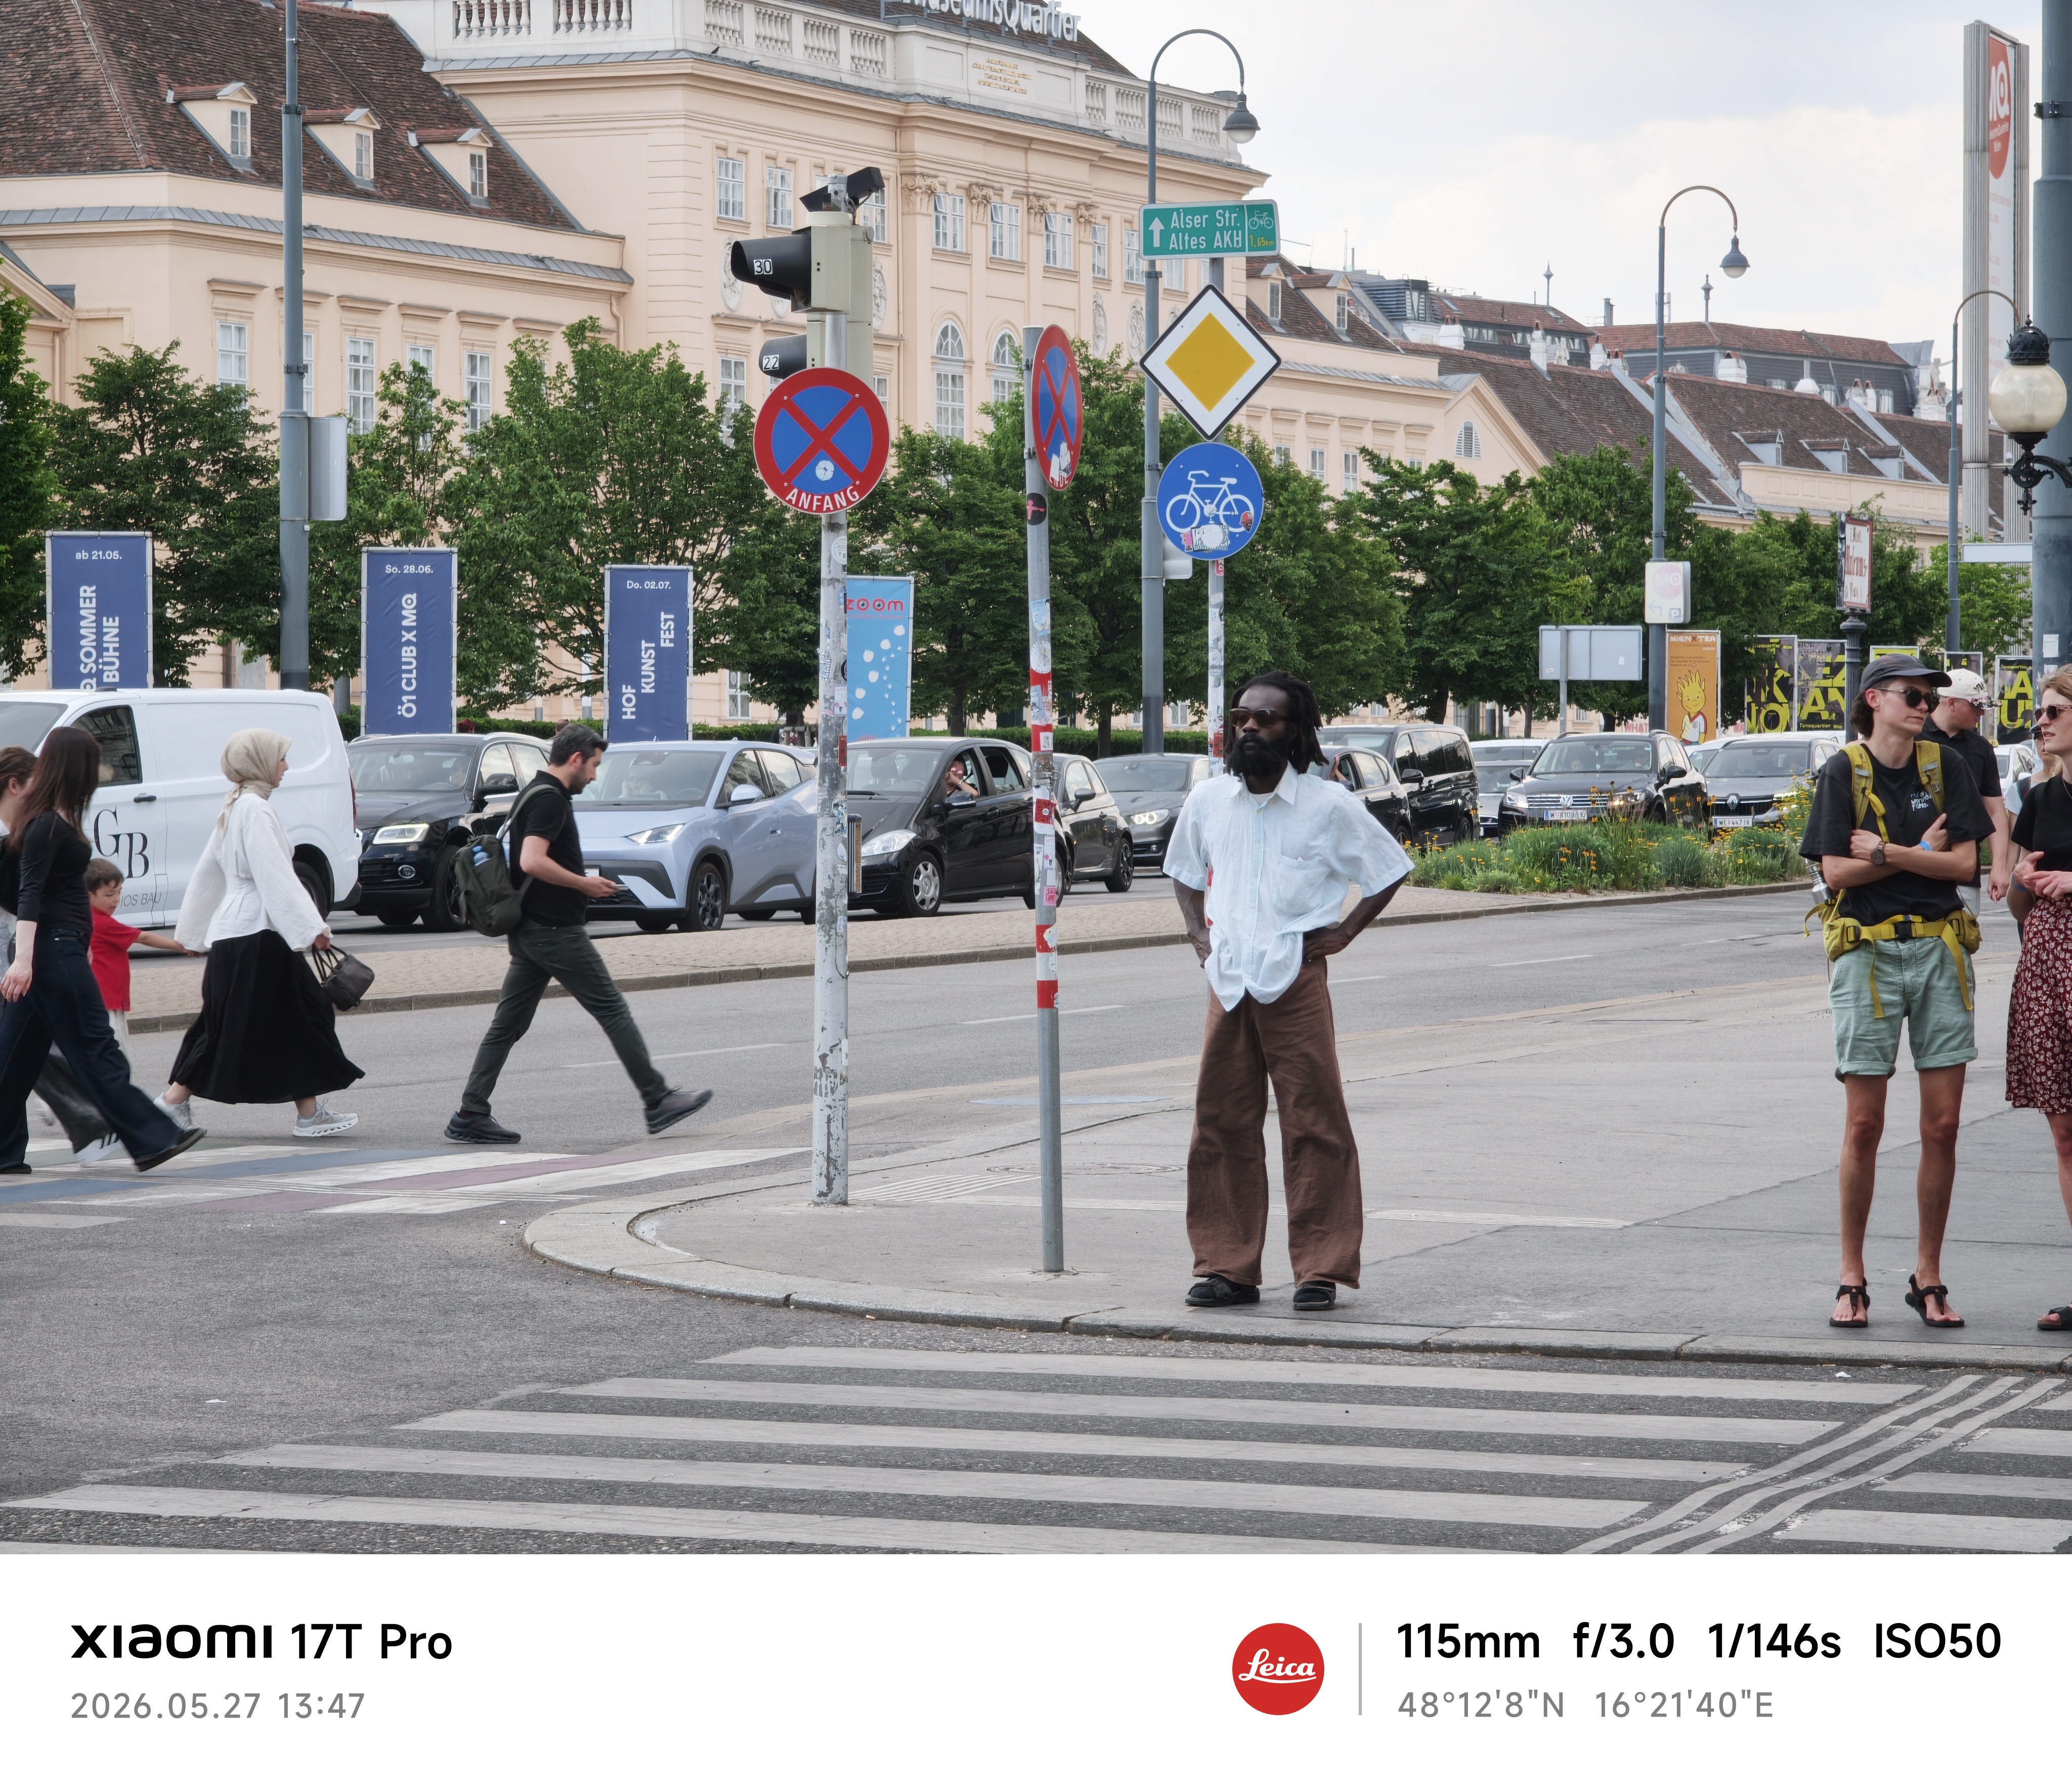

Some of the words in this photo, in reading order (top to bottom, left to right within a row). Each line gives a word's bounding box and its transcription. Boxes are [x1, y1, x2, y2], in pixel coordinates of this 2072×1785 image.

[1171, 210, 1208, 229] Alser
[1216, 209, 1240, 227] Str.
[1169, 232, 1206, 250] Altes
[1214, 230, 1242, 248] AKH
[754, 260, 772, 274] 30
[763, 356, 779, 370] 22
[786, 486, 859, 512] ANFANG
[76, 550, 89, 560] ab
[92, 551, 122, 560] 21.05.
[385, 565, 401, 574] So.
[403, 565, 434, 574] 28.06.
[627, 580, 642, 589] Do.
[644, 581, 671, 589] 02.07.
[402, 593, 417, 626] MQ
[79, 585, 96, 674] SOMMER
[402, 630, 417, 643] X
[661, 611, 674, 647] FEST
[98, 617, 119, 683] BÜHNE
[402, 646, 417, 691] CLUB
[641, 640, 655, 693] KUNST
[397, 696, 417, 718] Ö1
[622, 685, 636, 719] HOF
[141, 891, 162, 905] BAU
